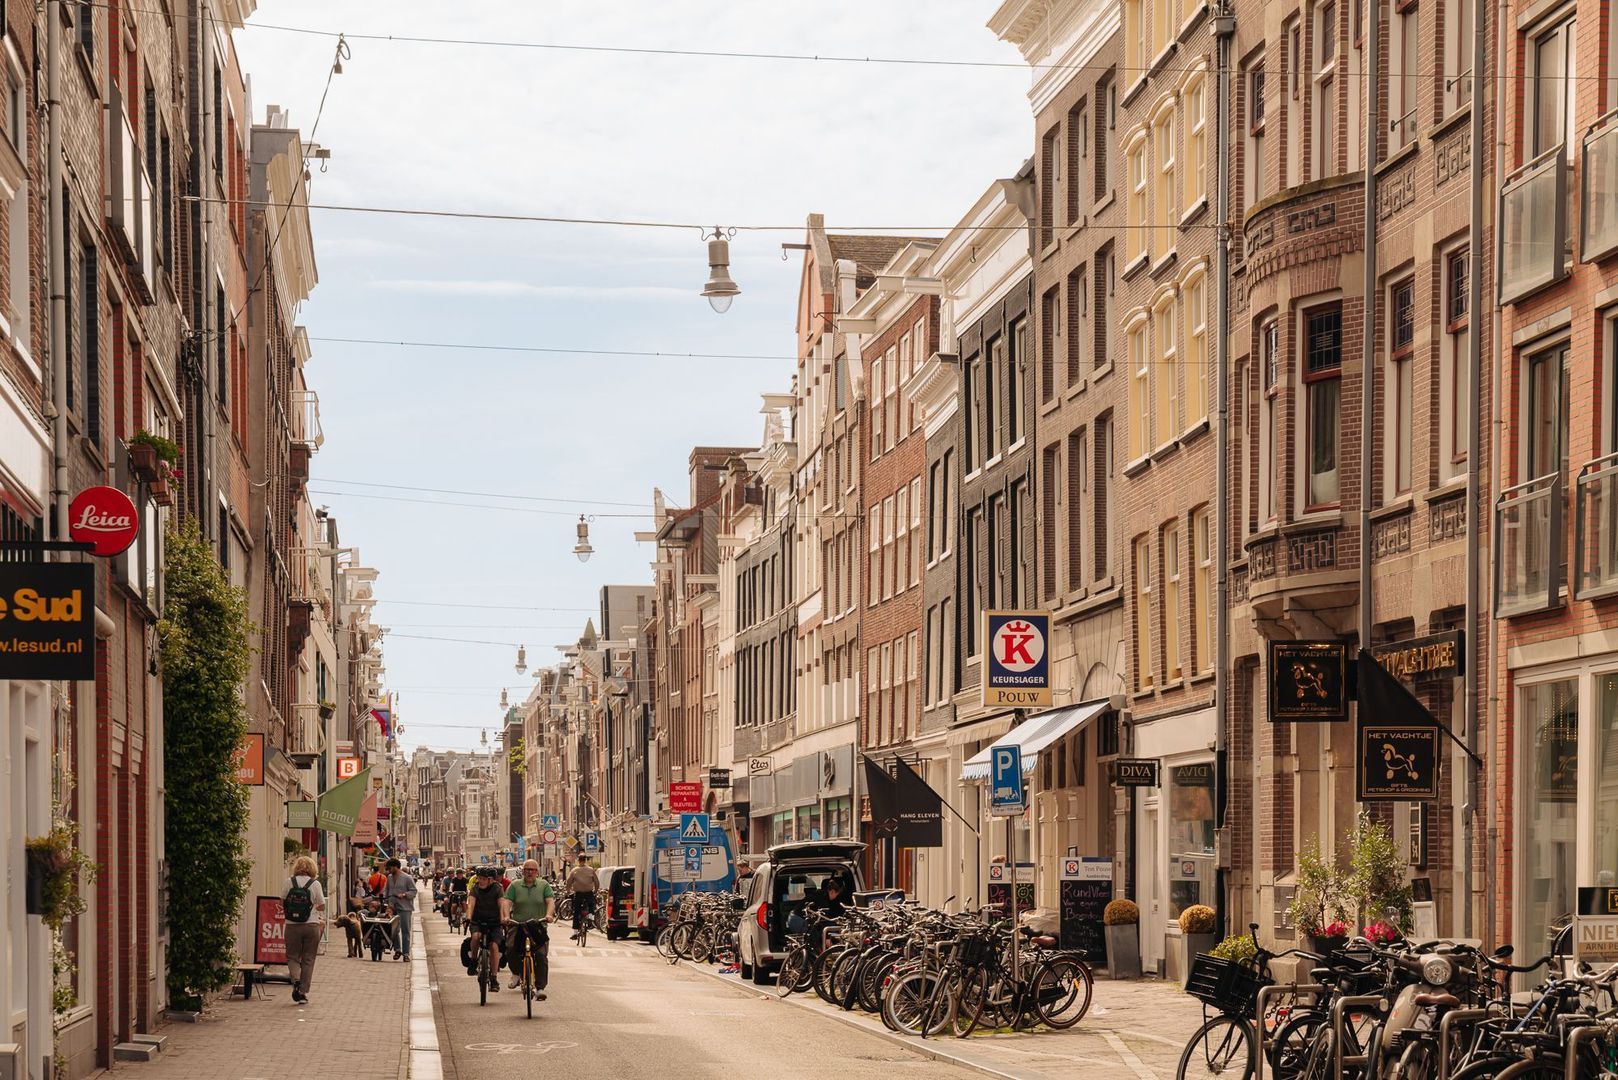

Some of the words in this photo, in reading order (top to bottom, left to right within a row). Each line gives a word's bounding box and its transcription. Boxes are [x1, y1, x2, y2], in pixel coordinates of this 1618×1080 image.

[73, 505, 132, 531] Leica
[13, 588, 82, 622] Sud
[1001, 634, 1036, 664] K
[992, 676, 1045, 684] KEURSLAGER
[998, 690, 1040, 703] POUW
[345, 763, 353, 773] B
[751, 759, 769, 771] Etos
[997, 751, 1013, 780] P
[1121, 766, 1152, 777] DIVA
[262, 922, 287, 939] SA
[1583, 924, 1618, 940] NIE
